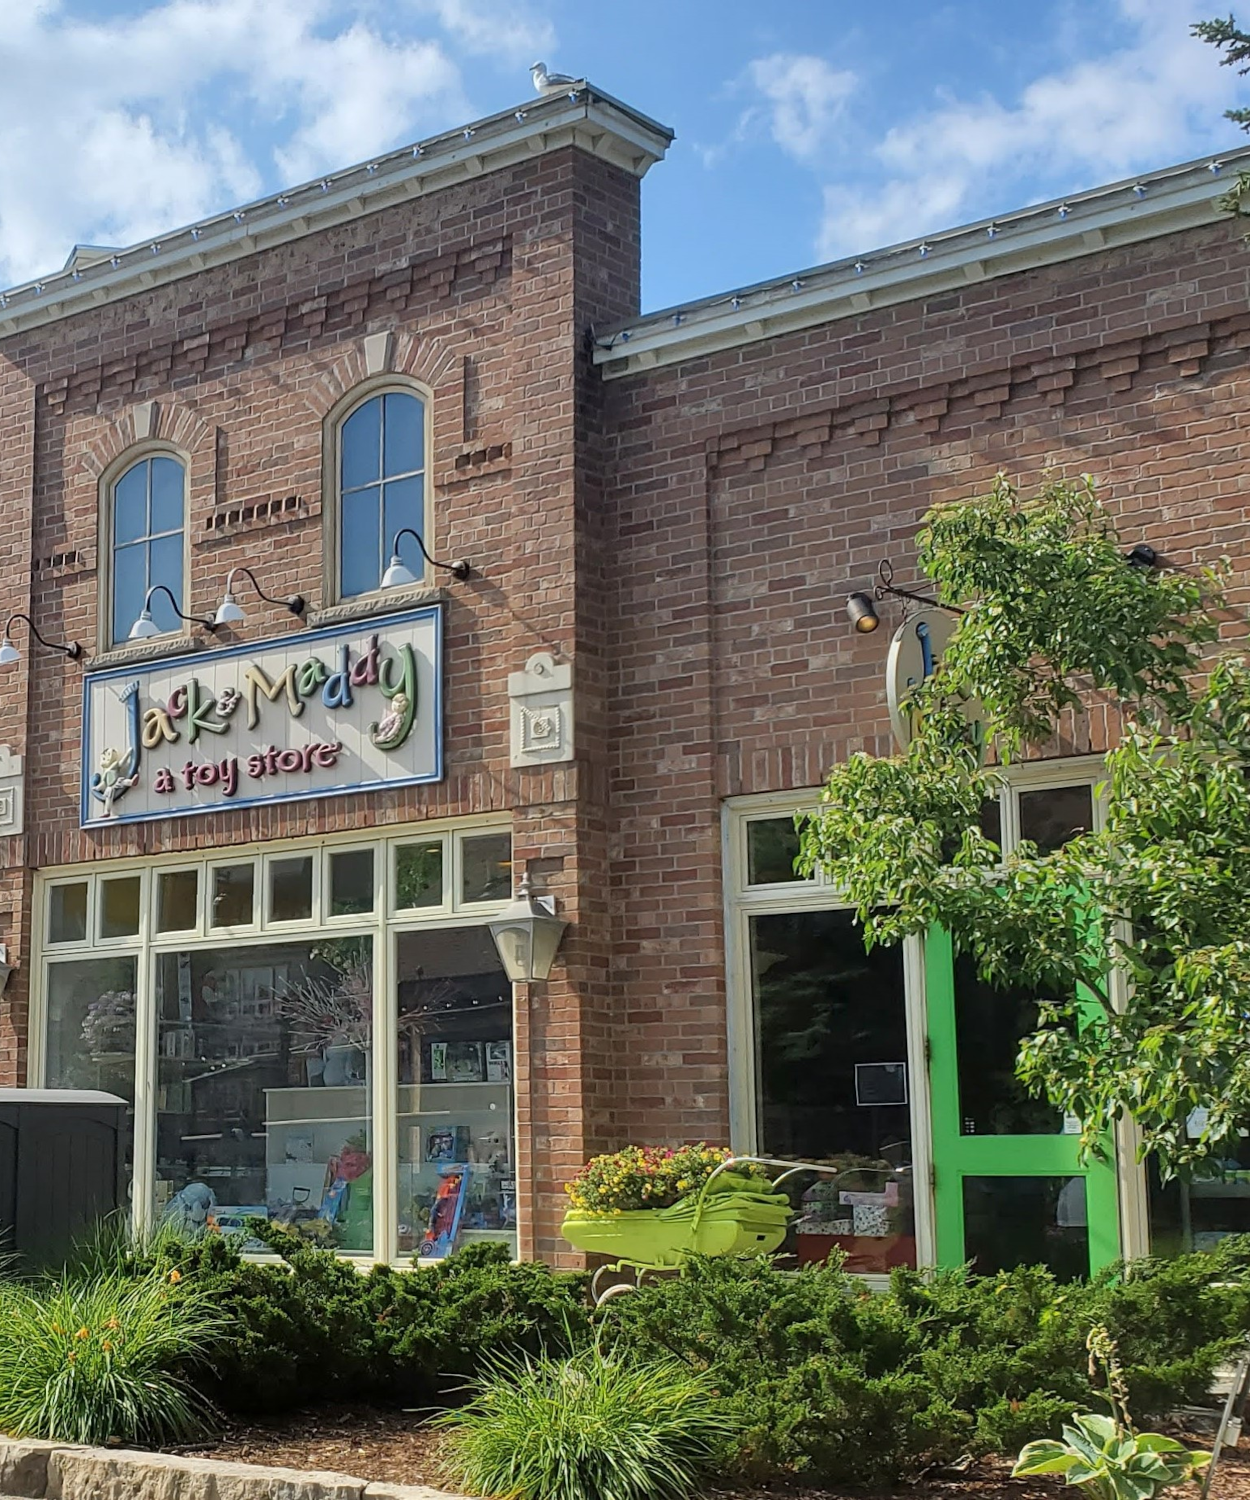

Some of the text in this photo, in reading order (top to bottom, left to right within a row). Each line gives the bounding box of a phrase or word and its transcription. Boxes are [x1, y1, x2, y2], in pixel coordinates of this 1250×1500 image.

[91, 633, 417, 803] Jack & Maddy
[154, 741, 342, 797] a toy store
